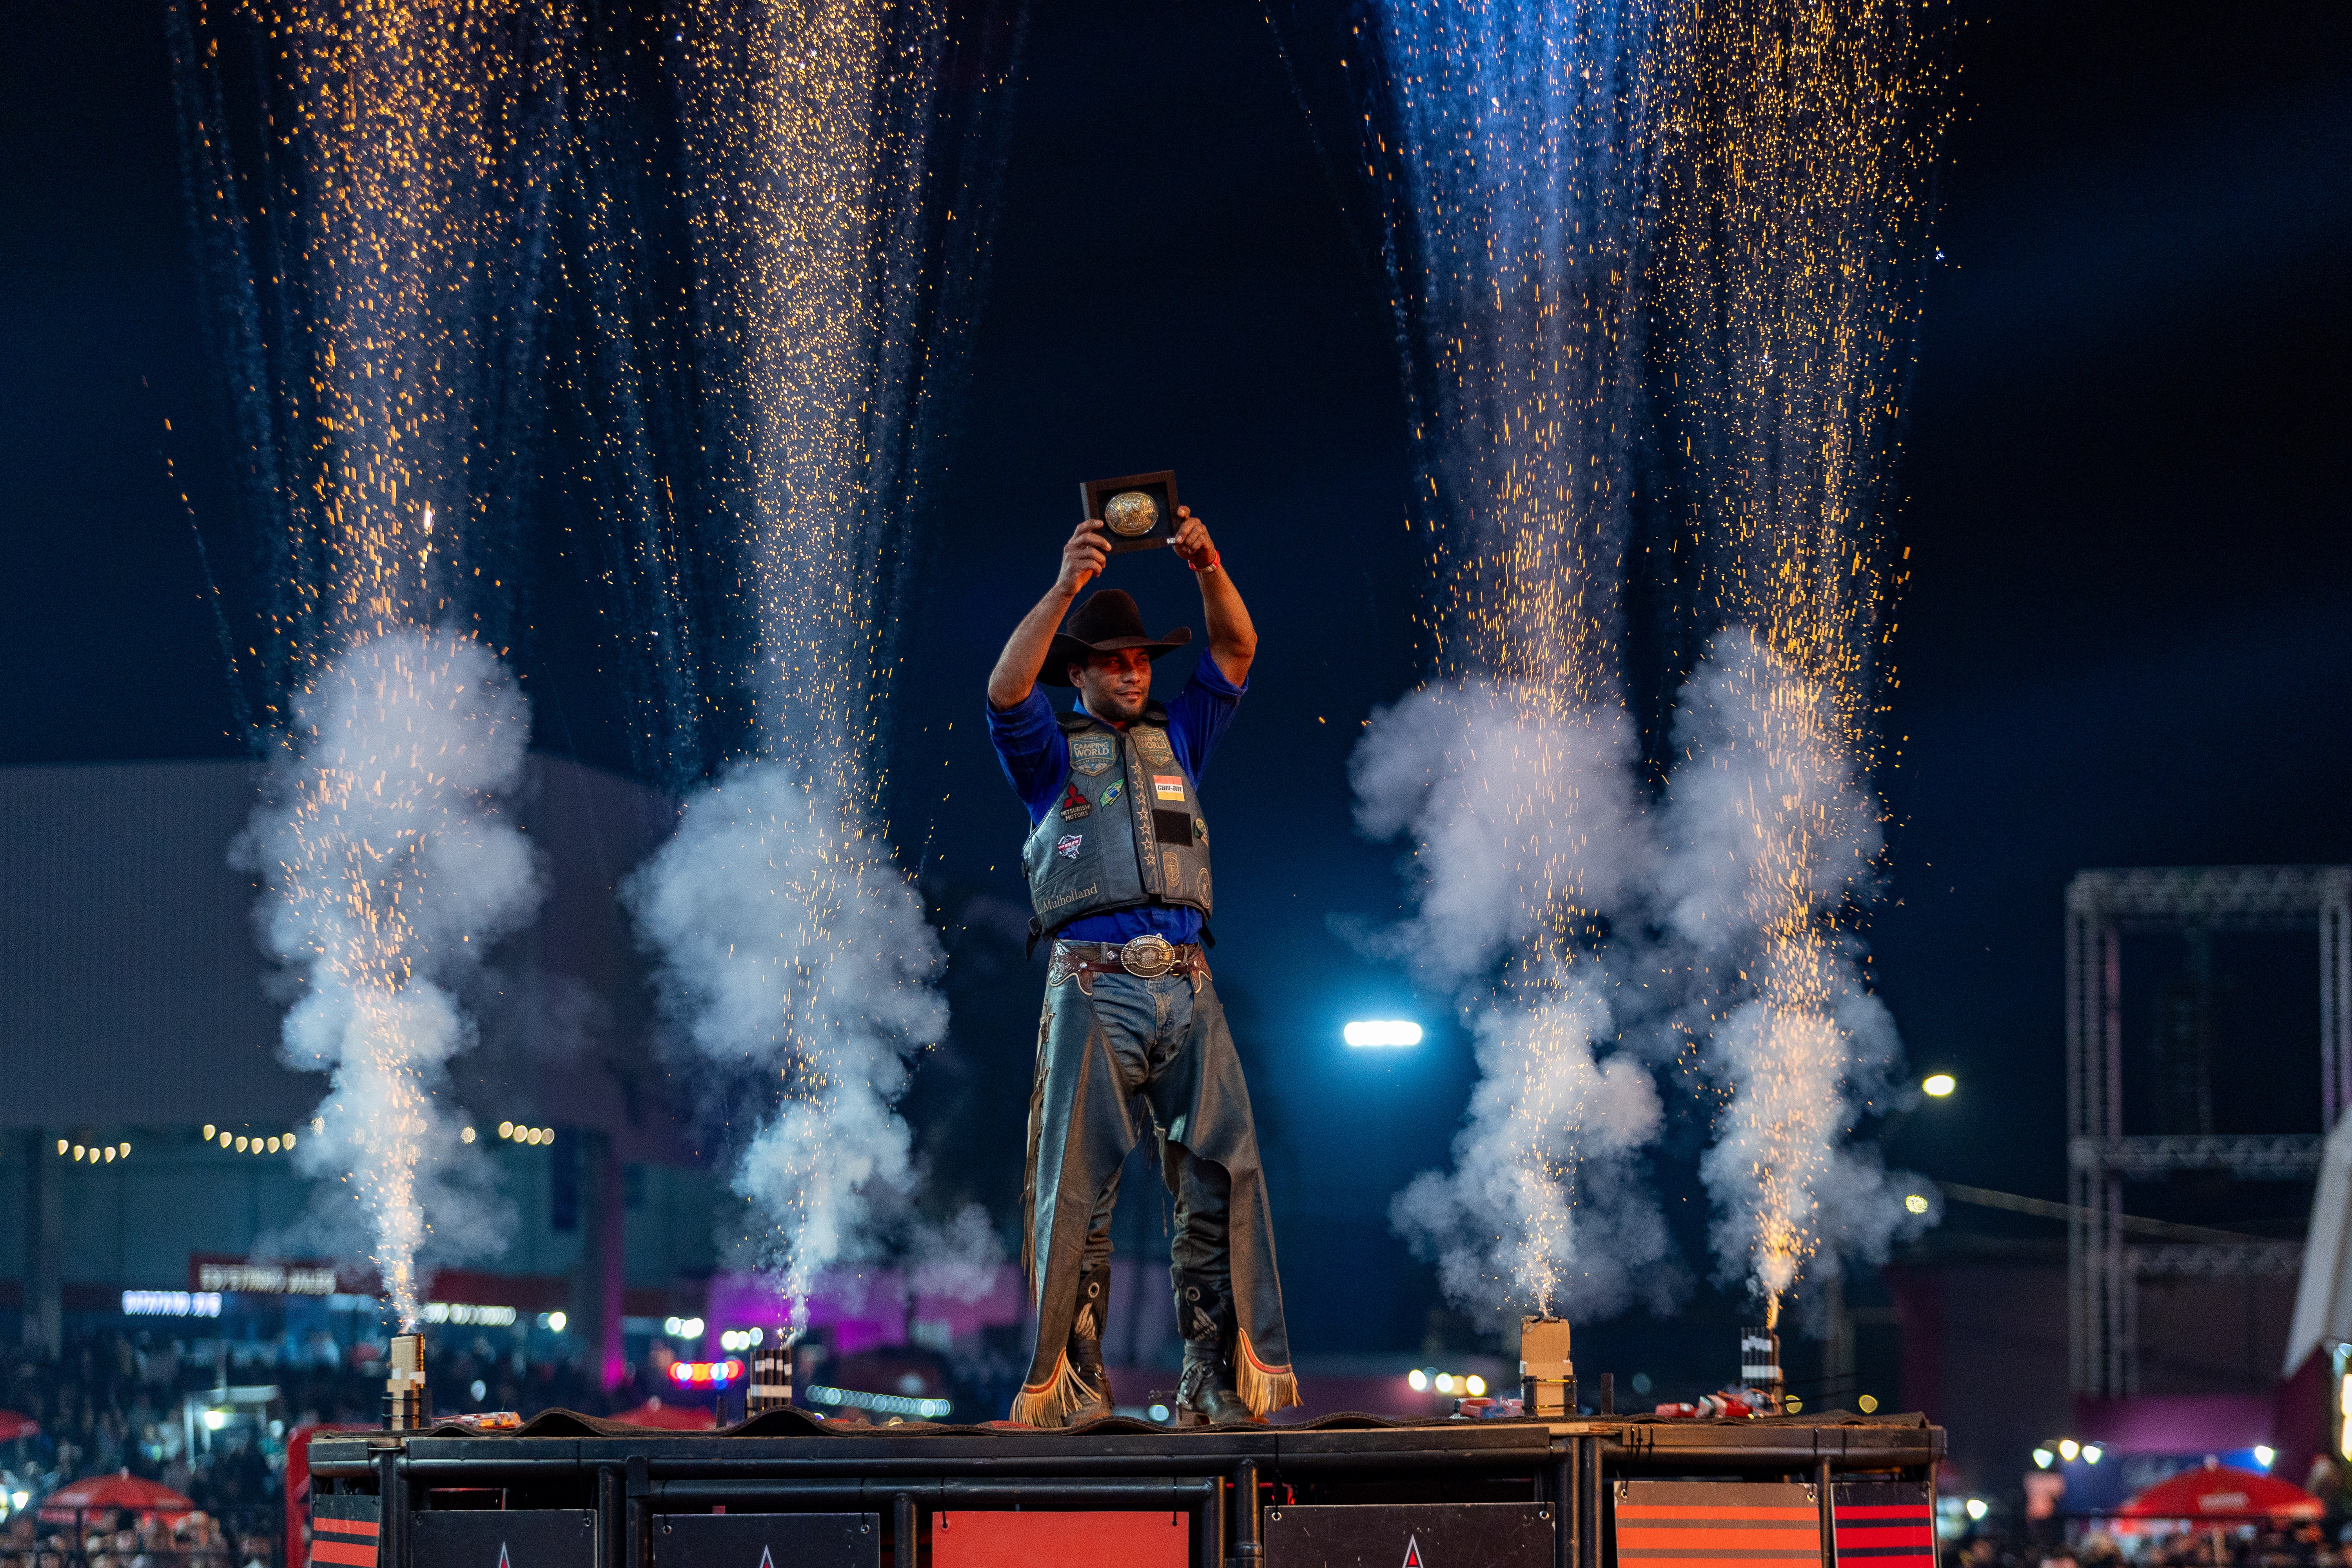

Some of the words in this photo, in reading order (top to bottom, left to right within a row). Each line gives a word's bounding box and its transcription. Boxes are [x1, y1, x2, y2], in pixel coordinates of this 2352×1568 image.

[1074, 748, 1110, 757] WORLD
[1061, 804, 1091, 817] MITSUBISHI
[1065, 810, 1089, 821] MOTORS
[1058, 839, 1079, 850] PBR
[1043, 882, 1098, 912] Mulholland
